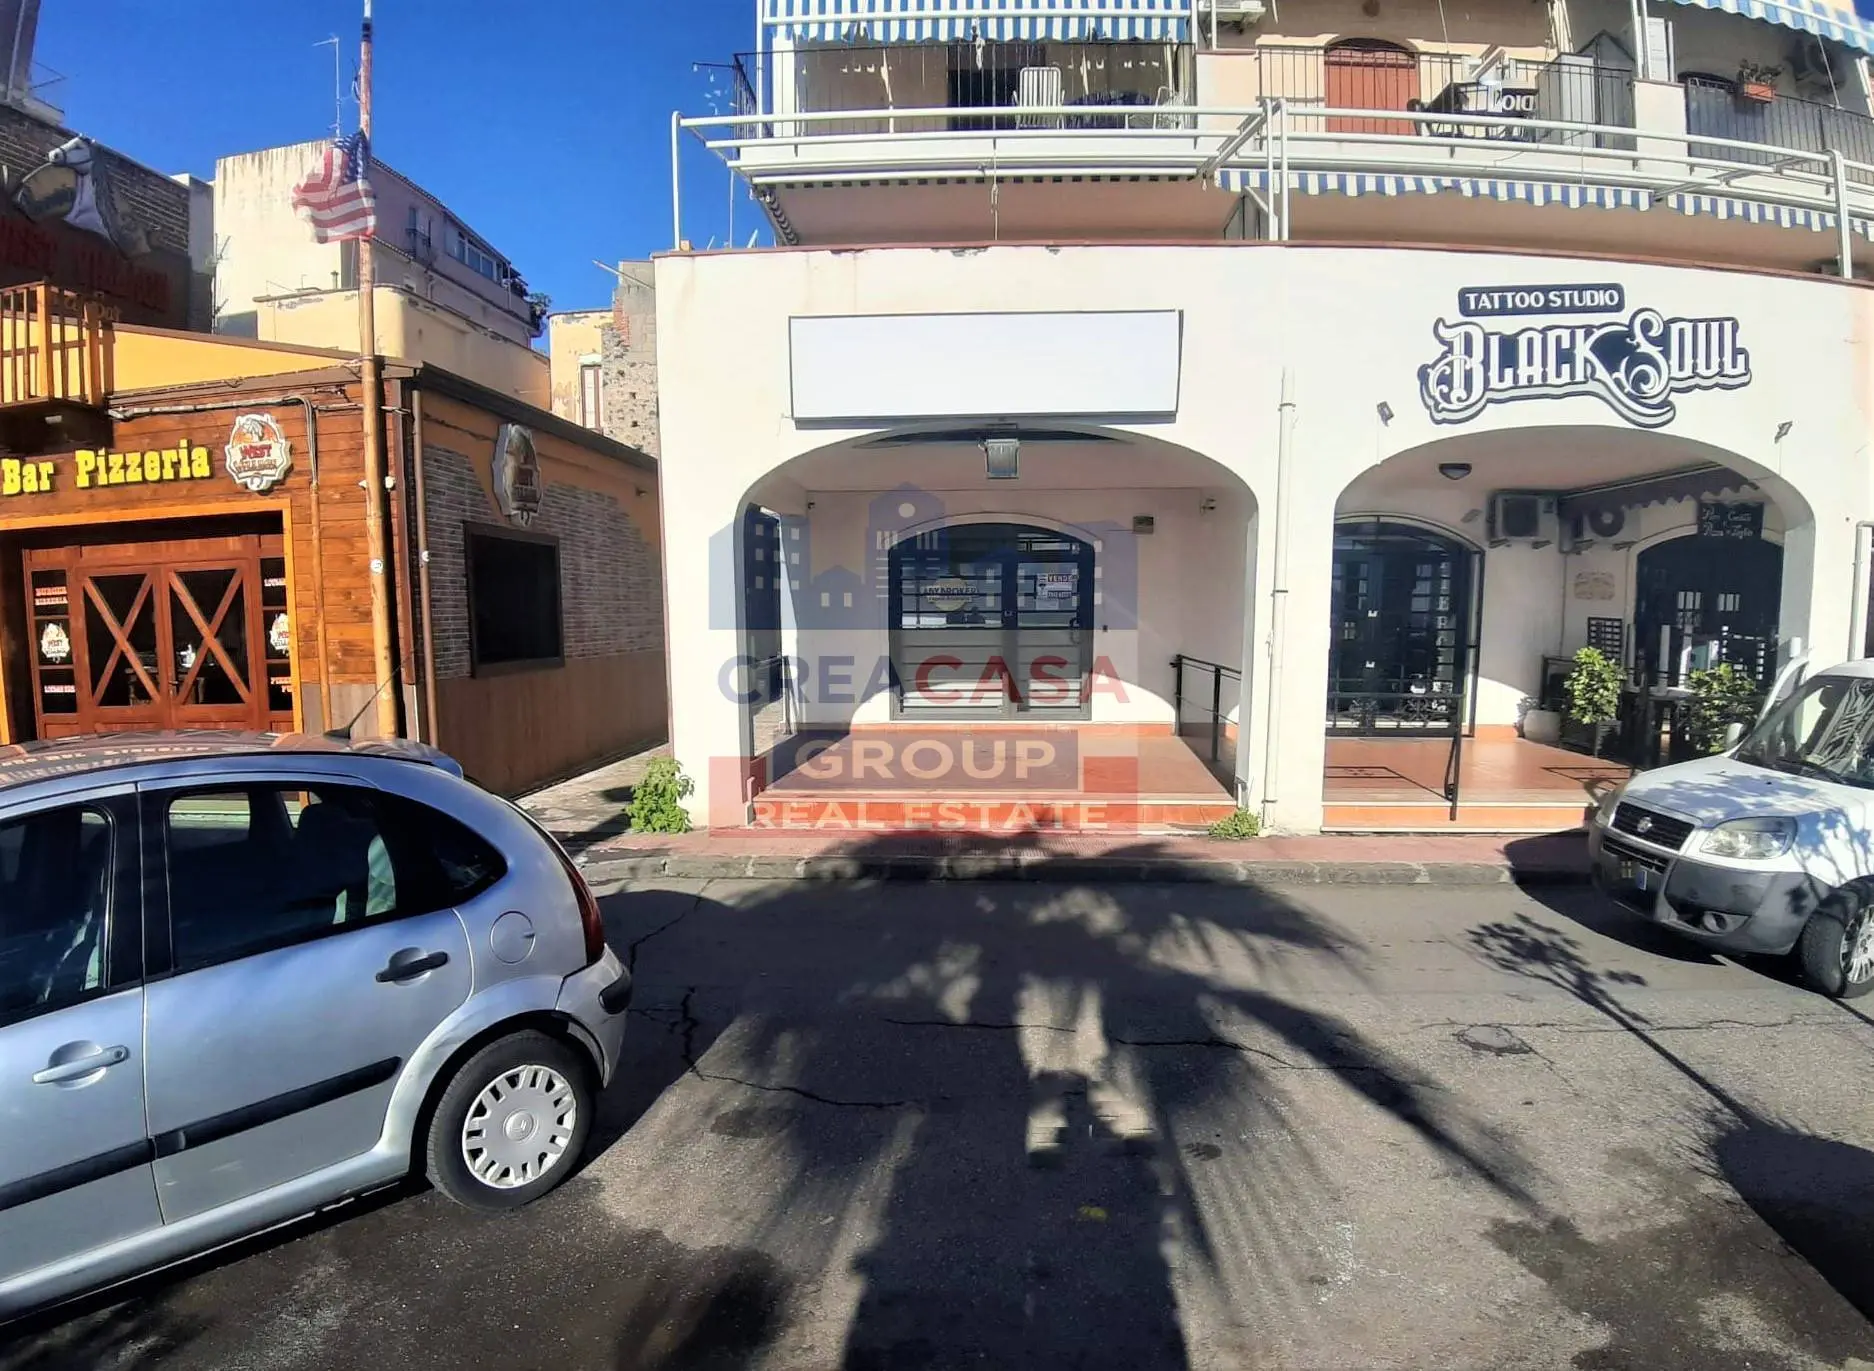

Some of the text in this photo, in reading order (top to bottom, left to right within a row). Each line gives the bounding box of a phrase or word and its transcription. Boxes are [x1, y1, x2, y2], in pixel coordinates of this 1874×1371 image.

[1465, 288, 1619, 310] TATTOO STUDIO
[1, 438, 212, 496] Bar Pizzeria
